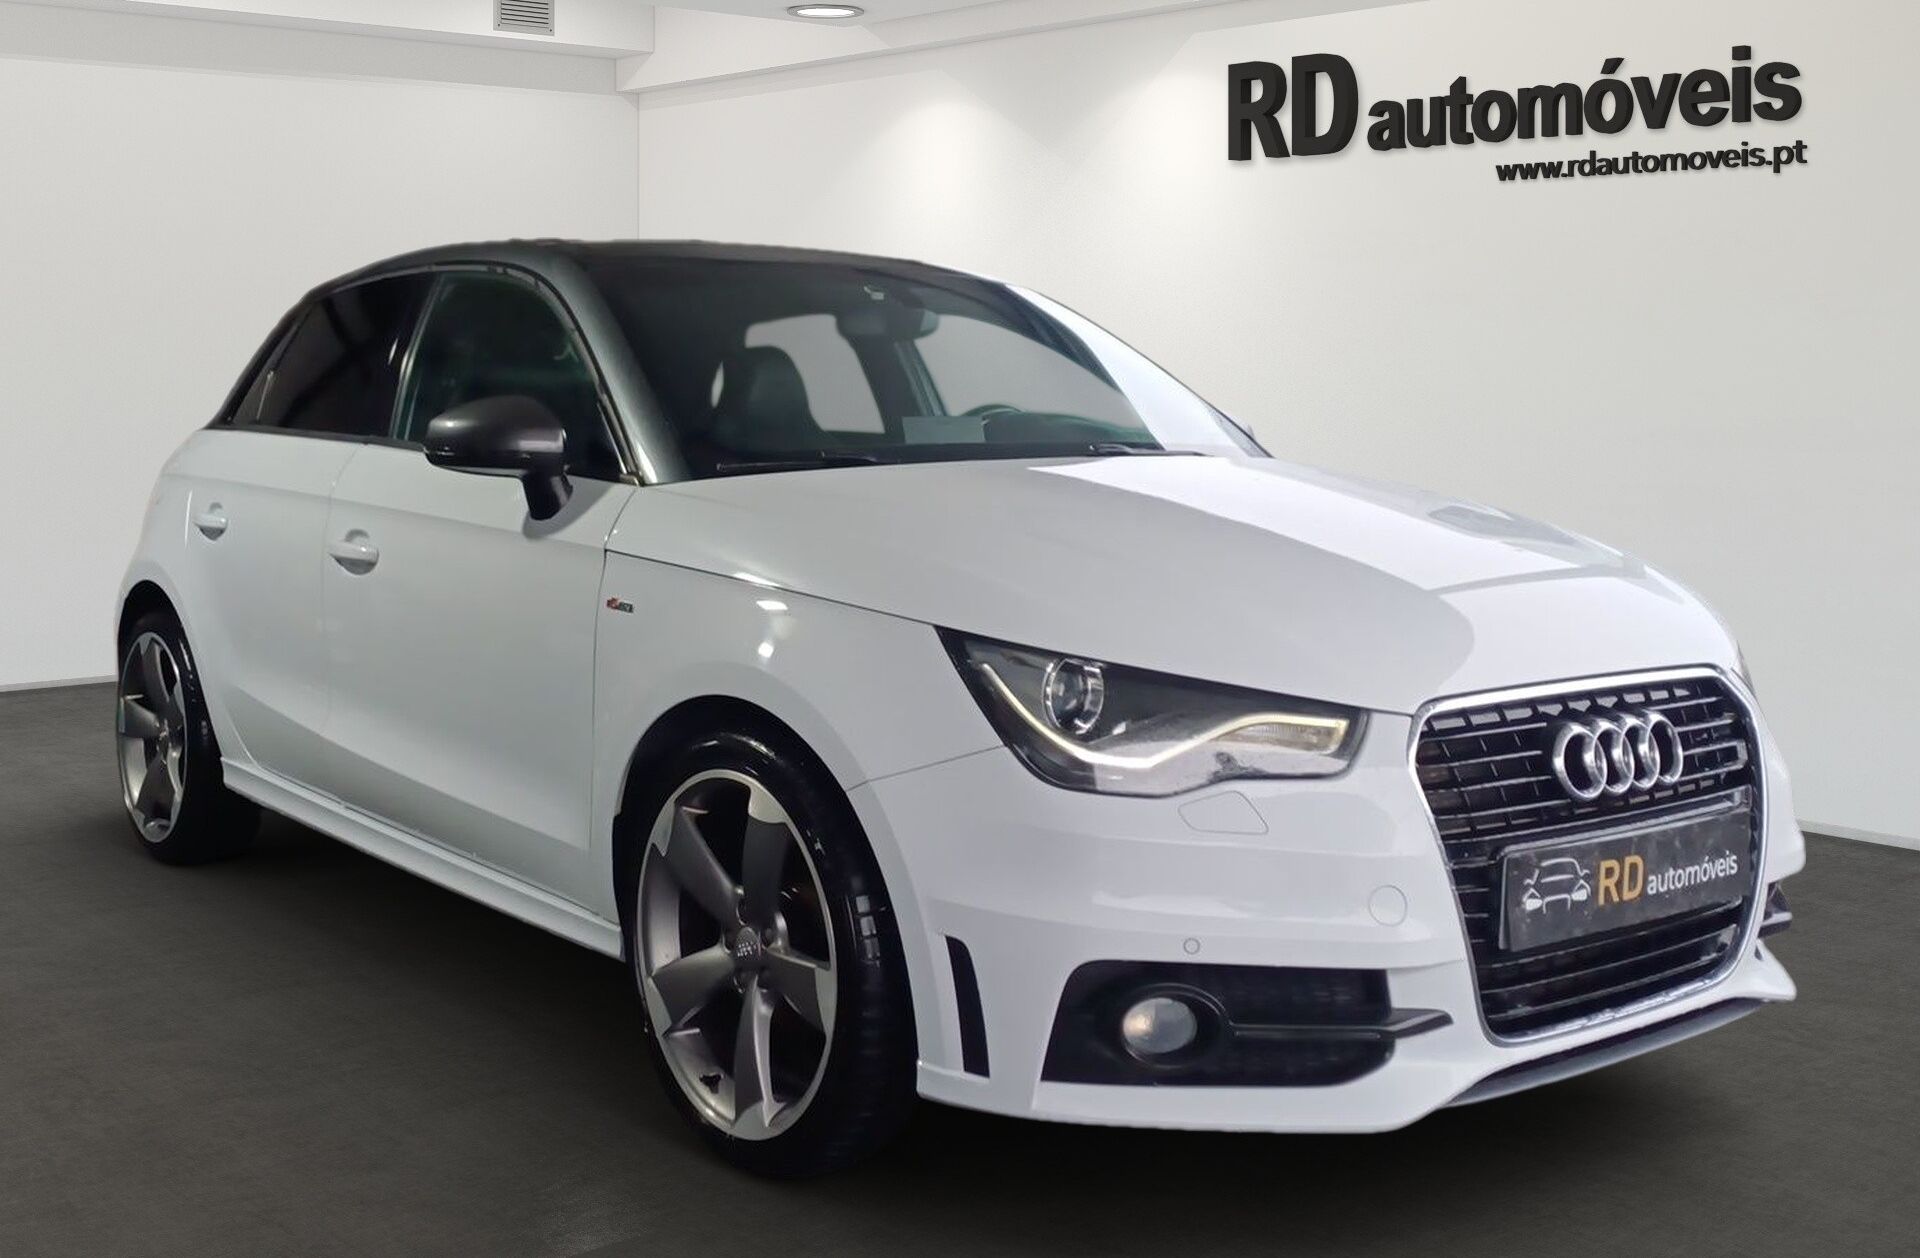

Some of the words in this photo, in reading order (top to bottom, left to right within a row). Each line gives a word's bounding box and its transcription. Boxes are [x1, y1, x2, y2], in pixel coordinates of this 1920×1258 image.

[1228, 53, 1359, 161] RD
[1366, 45, 1801, 151] automóveis
[1496, 140, 1808, 181] www.rdautomoveis.pt
[1598, 854, 1644, 905] RD
[1646, 850, 1738, 894] automóveis
